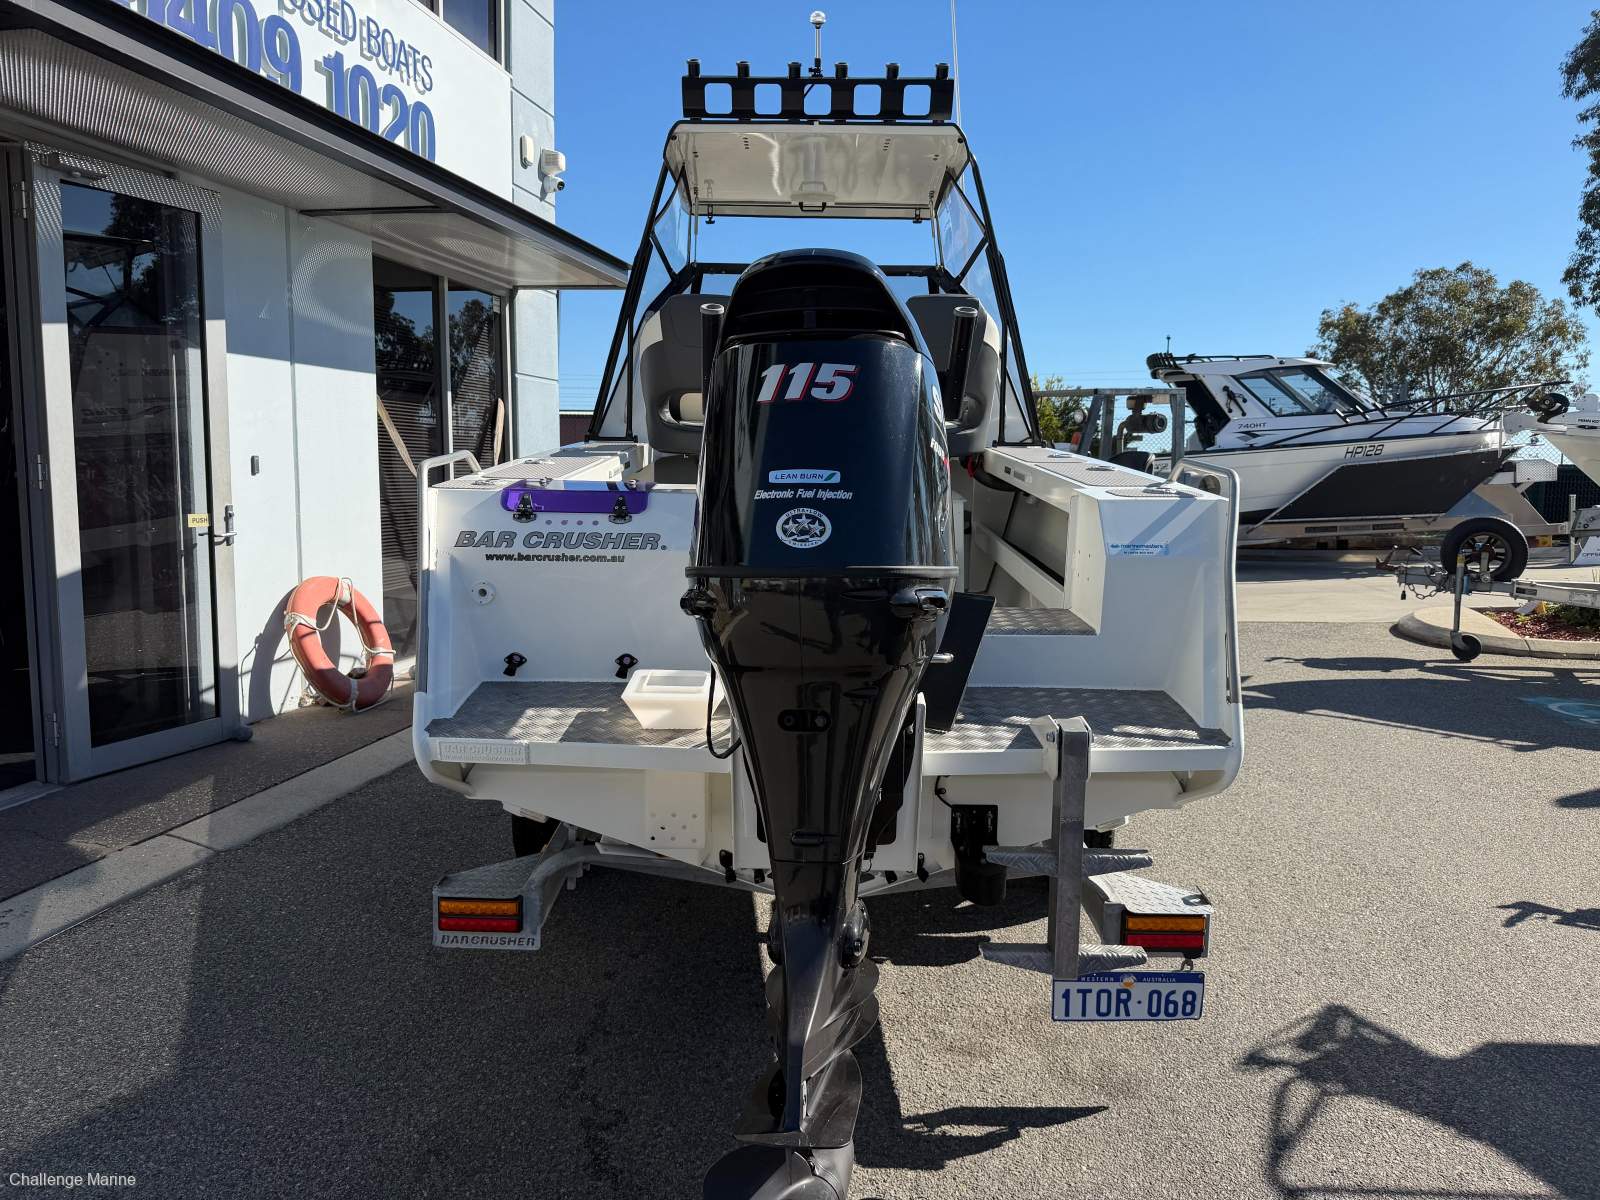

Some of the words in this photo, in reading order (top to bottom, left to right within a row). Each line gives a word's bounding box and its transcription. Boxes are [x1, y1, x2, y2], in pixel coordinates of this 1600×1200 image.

[290, 0, 357, 43] SED
[366, 15, 434, 92] BOATS
[118, 0, 303, 95] 409
[322, 50, 436, 164] 1020
[756, 362, 861, 404] 115
[1344, 444, 1385, 459] HP128
[774, 472, 798, 480] LEAN
[800, 472, 824, 480] BURN
[754, 488, 795, 500] Electronic
[796, 488, 815, 499] Fuel
[816, 488, 853, 500] Injection
[453, 530, 518, 548] BAR
[485, 551, 625, 564] www.barcrusher.com.au
